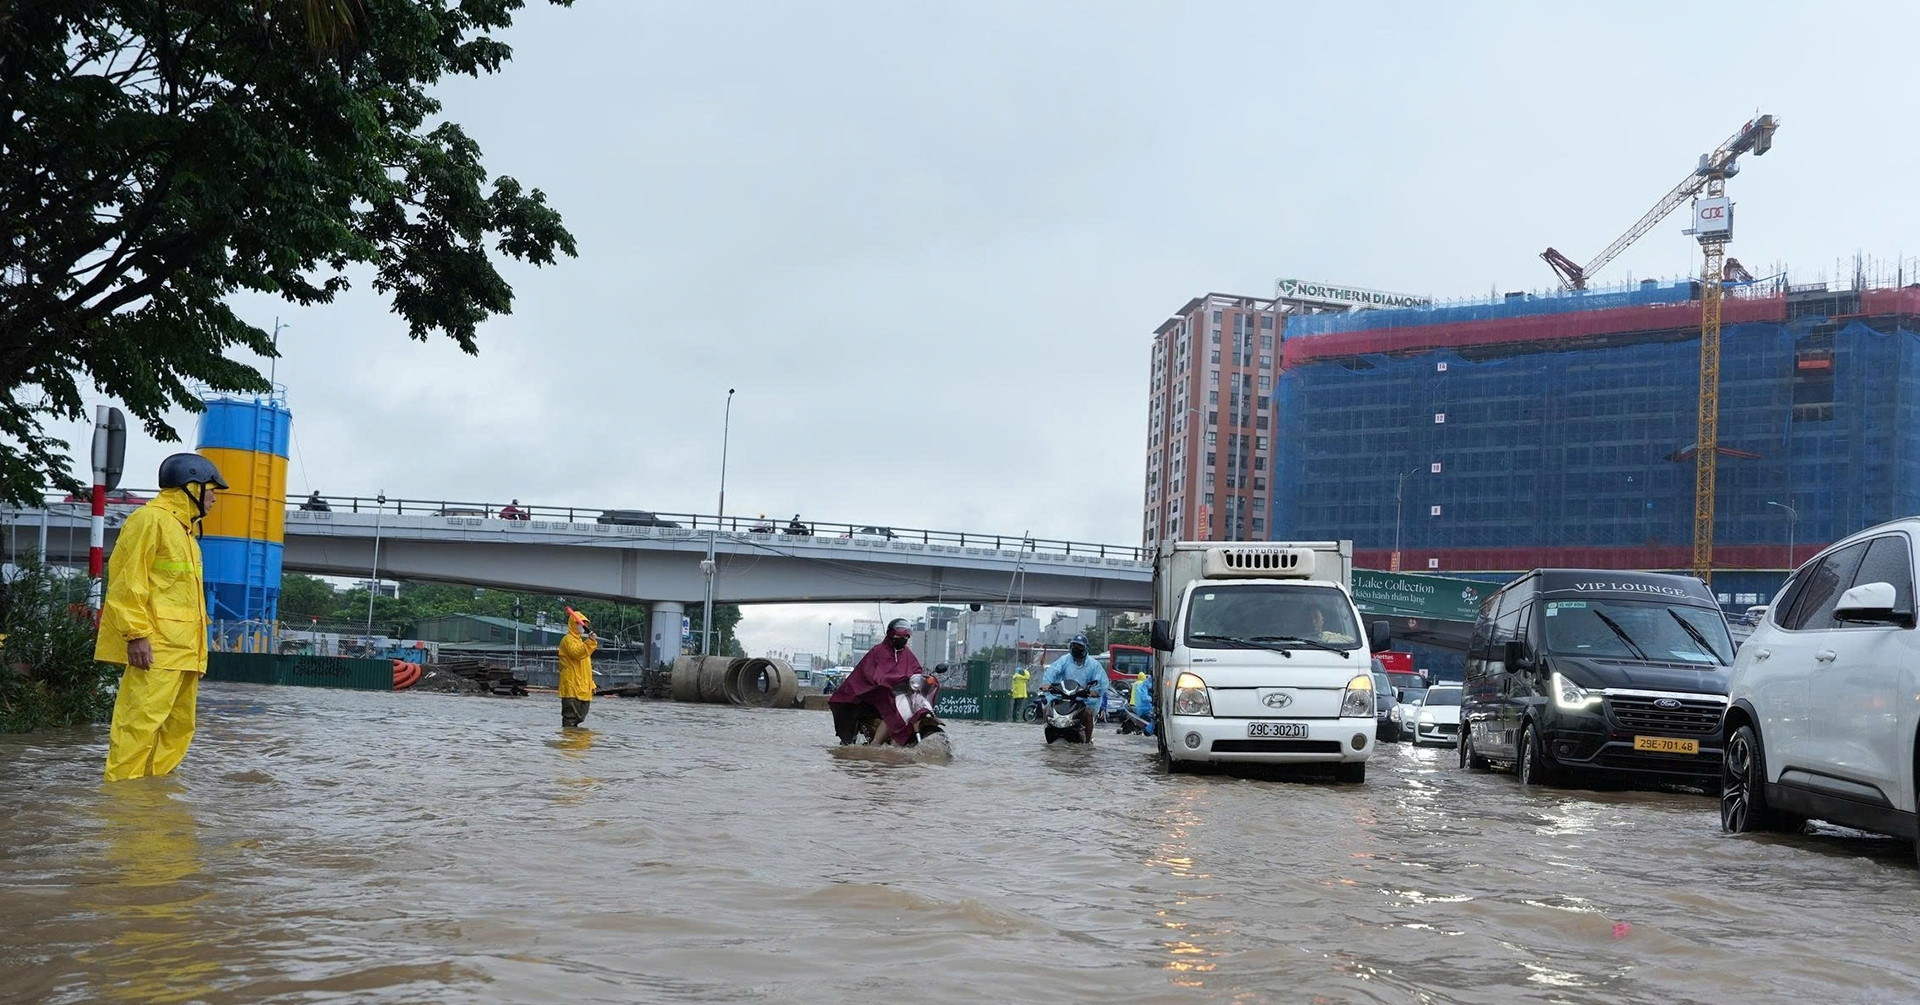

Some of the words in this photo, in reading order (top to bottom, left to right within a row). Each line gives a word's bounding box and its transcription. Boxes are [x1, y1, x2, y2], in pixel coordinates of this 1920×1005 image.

[1298, 284, 1370, 302] NORTHERN
[1373, 293, 1430, 307] DIAMOND
[1358, 577, 1382, 588] Lake
[1385, 579, 1434, 594] Collection
[1575, 582, 1606, 591] VIP
[1612, 582, 1685, 597] LOUNGE
[1640, 739, 1693, 751] 29E-701.48
